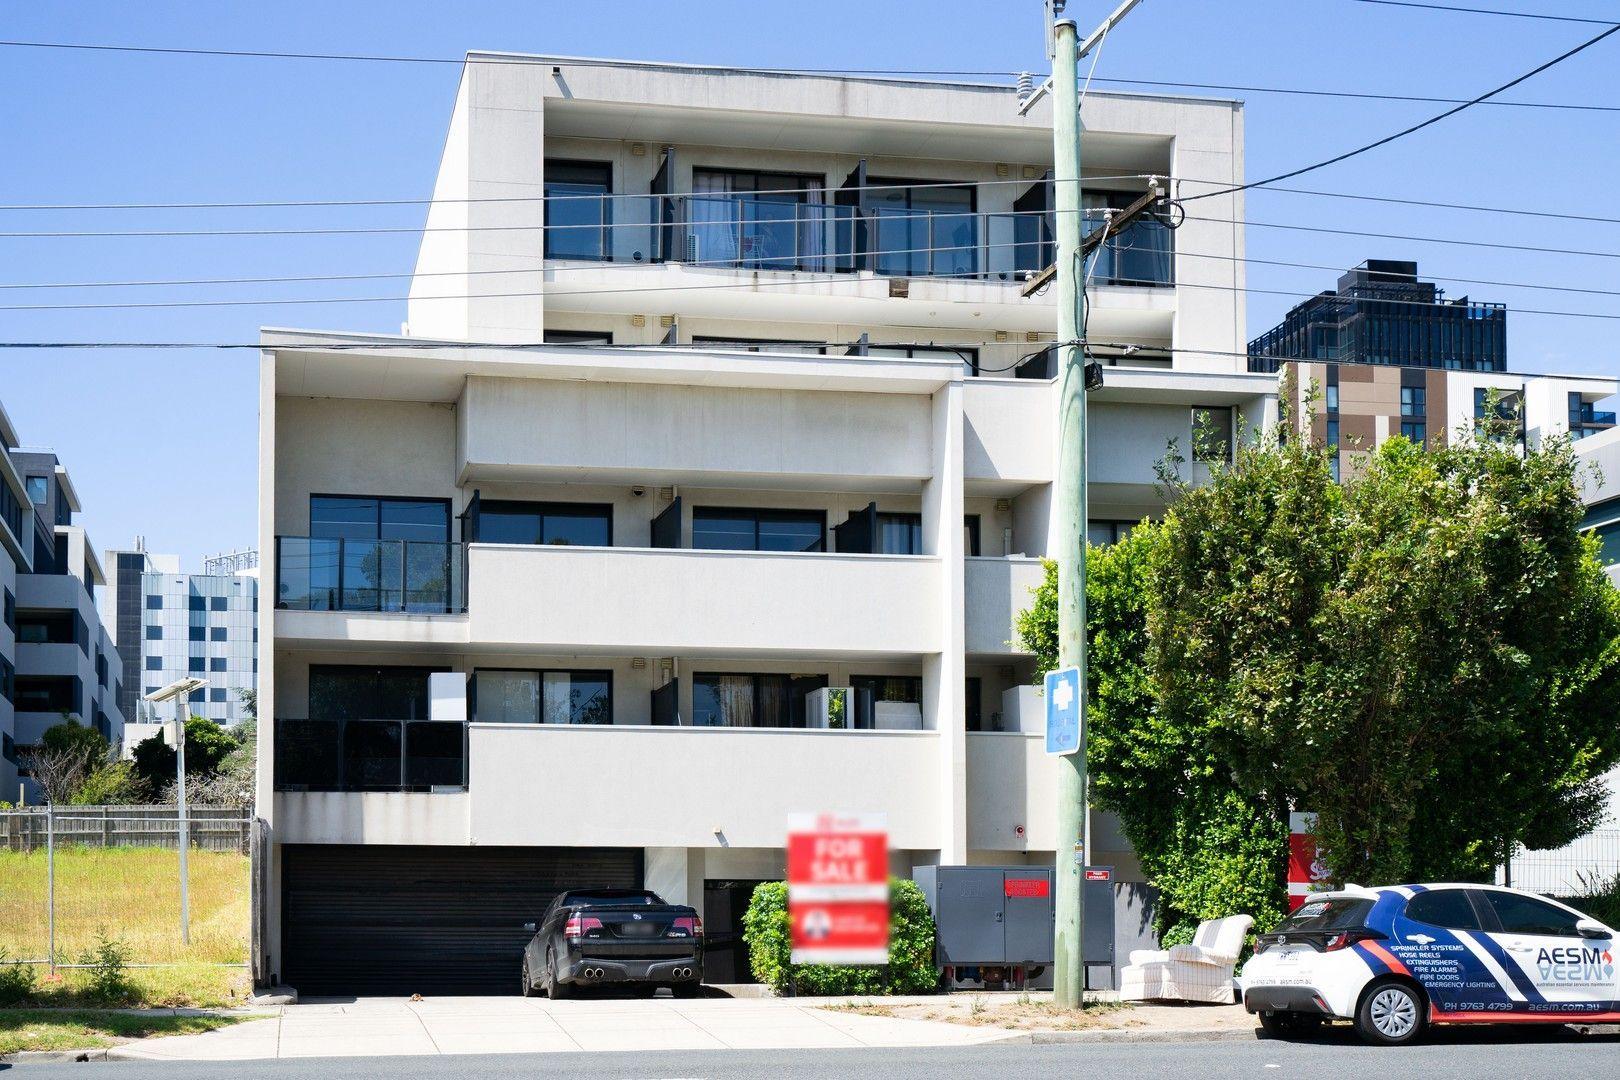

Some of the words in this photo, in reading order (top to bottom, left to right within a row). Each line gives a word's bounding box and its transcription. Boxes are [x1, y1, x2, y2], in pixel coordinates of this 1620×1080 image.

[814, 838, 862, 857] FOR
[811, 860, 868, 881] SALE
[1536, 948, 1601, 964] AESM
[1528, 1003, 1600, 1011] aesm.com.au
